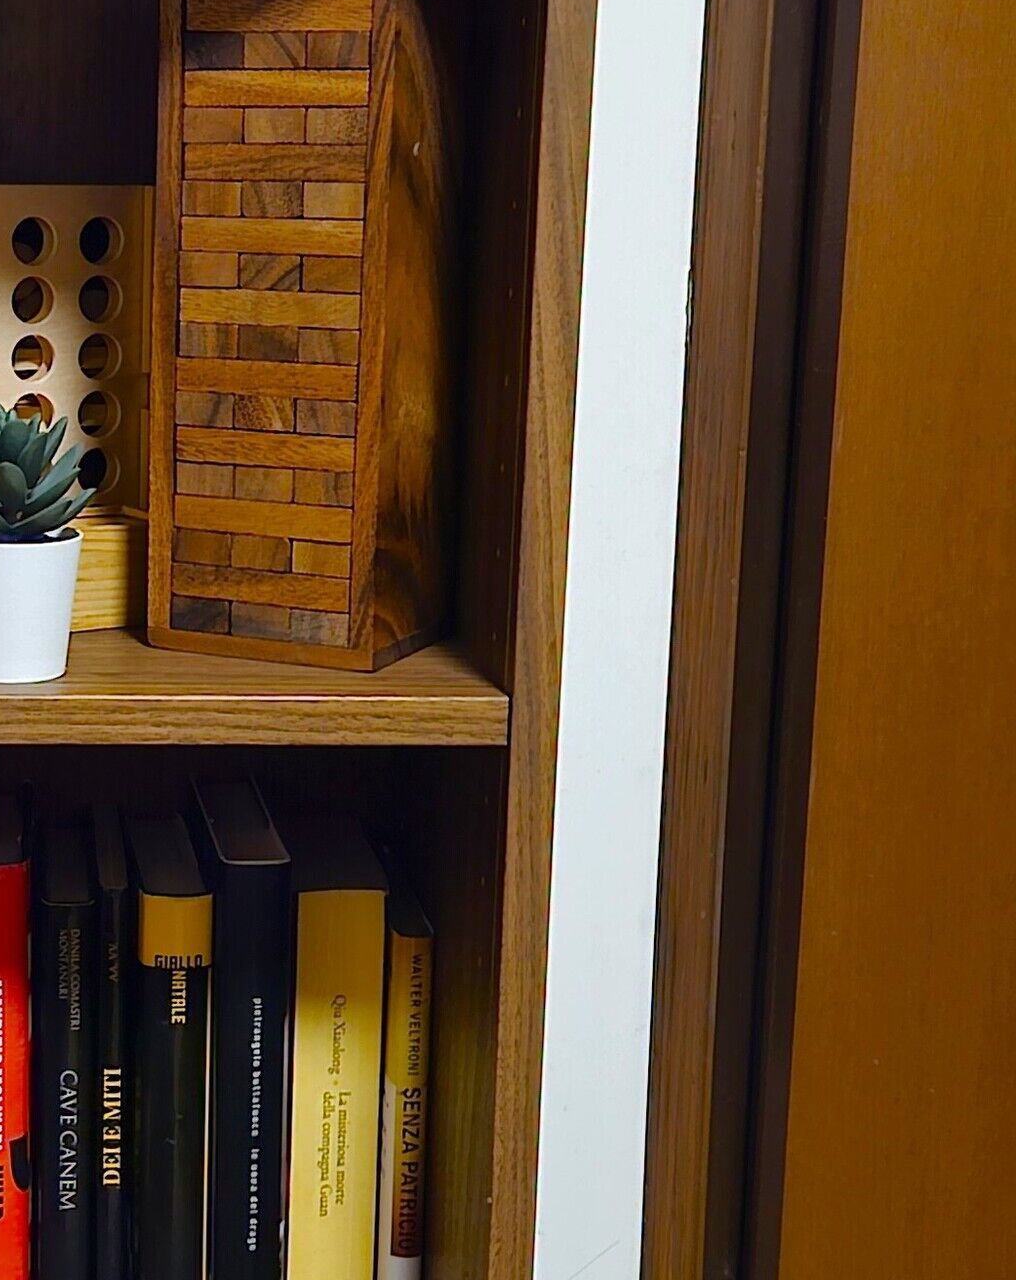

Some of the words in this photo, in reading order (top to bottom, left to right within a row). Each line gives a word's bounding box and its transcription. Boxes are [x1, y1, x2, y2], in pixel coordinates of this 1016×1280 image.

[68, 928, 81, 972] DANILA
[155, 954, 203, 969] GIALLO
[68, 973, 81, 1031] COMASTRI
[170, 970, 187, 1025] NATALE
[330, 993, 347, 1017] Qiu
[410, 953, 424, 1007] WALTER
[328, 1021, 346, 1075] Xiaolong
[407, 1011, 422, 1076] VELTRONI
[57, 1069, 78, 1125] CAVE
[101, 1066, 122, 1121] MITI
[321, 1091, 336, 1120] della
[337, 1091, 352, 1106] La
[101, 1126, 122, 1141] E
[317, 1122, 333, 1182] compagna
[335, 1109, 351, 1167] misteriosa
[57, 1129, 78, 1211] CANEM
[101, 1146, 122, 1188] DEI
[335, 1170, 348, 1205] morte
[246, 1195, 260, 1214] del
[398, 1161, 418, 1250] PATRICIO
[245, 1217, 259, 1252] drago
